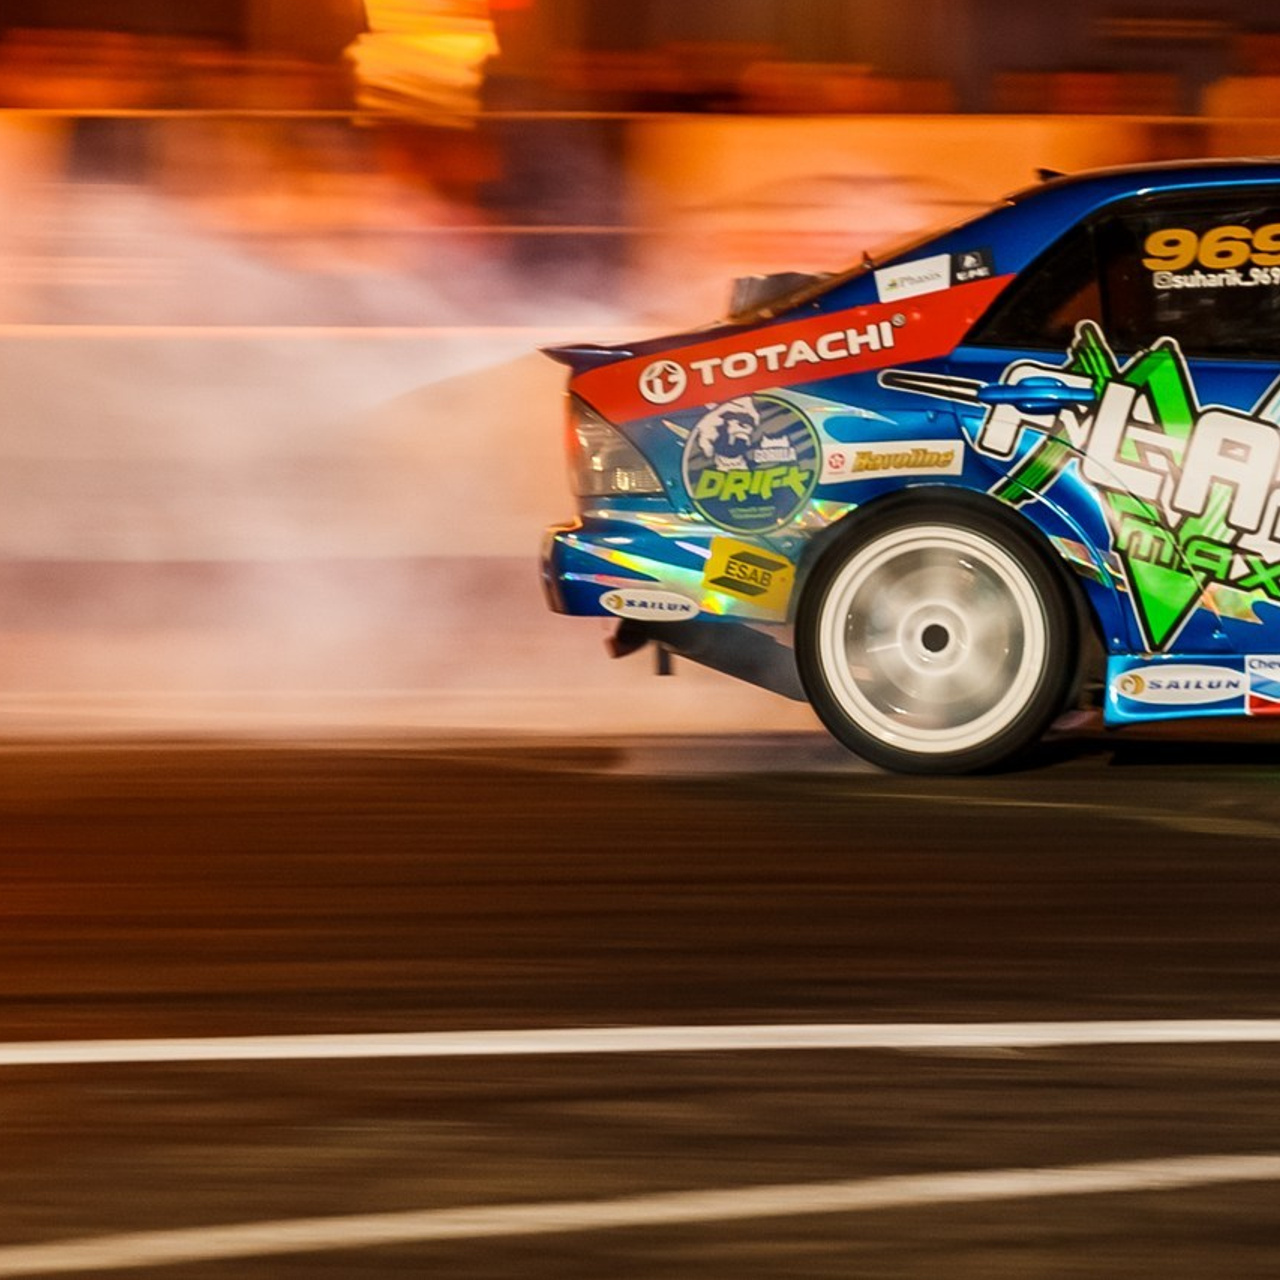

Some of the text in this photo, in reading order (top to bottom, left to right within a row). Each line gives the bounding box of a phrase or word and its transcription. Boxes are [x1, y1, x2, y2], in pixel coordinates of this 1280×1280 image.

[690, 320, 895, 386] TOTACHI
[694, 466, 810, 503] DRIFT
[724, 559, 773, 588] ESAB
[625, 598, 691, 613] SAILUN
[1149, 679, 1241, 690] SAILUN
